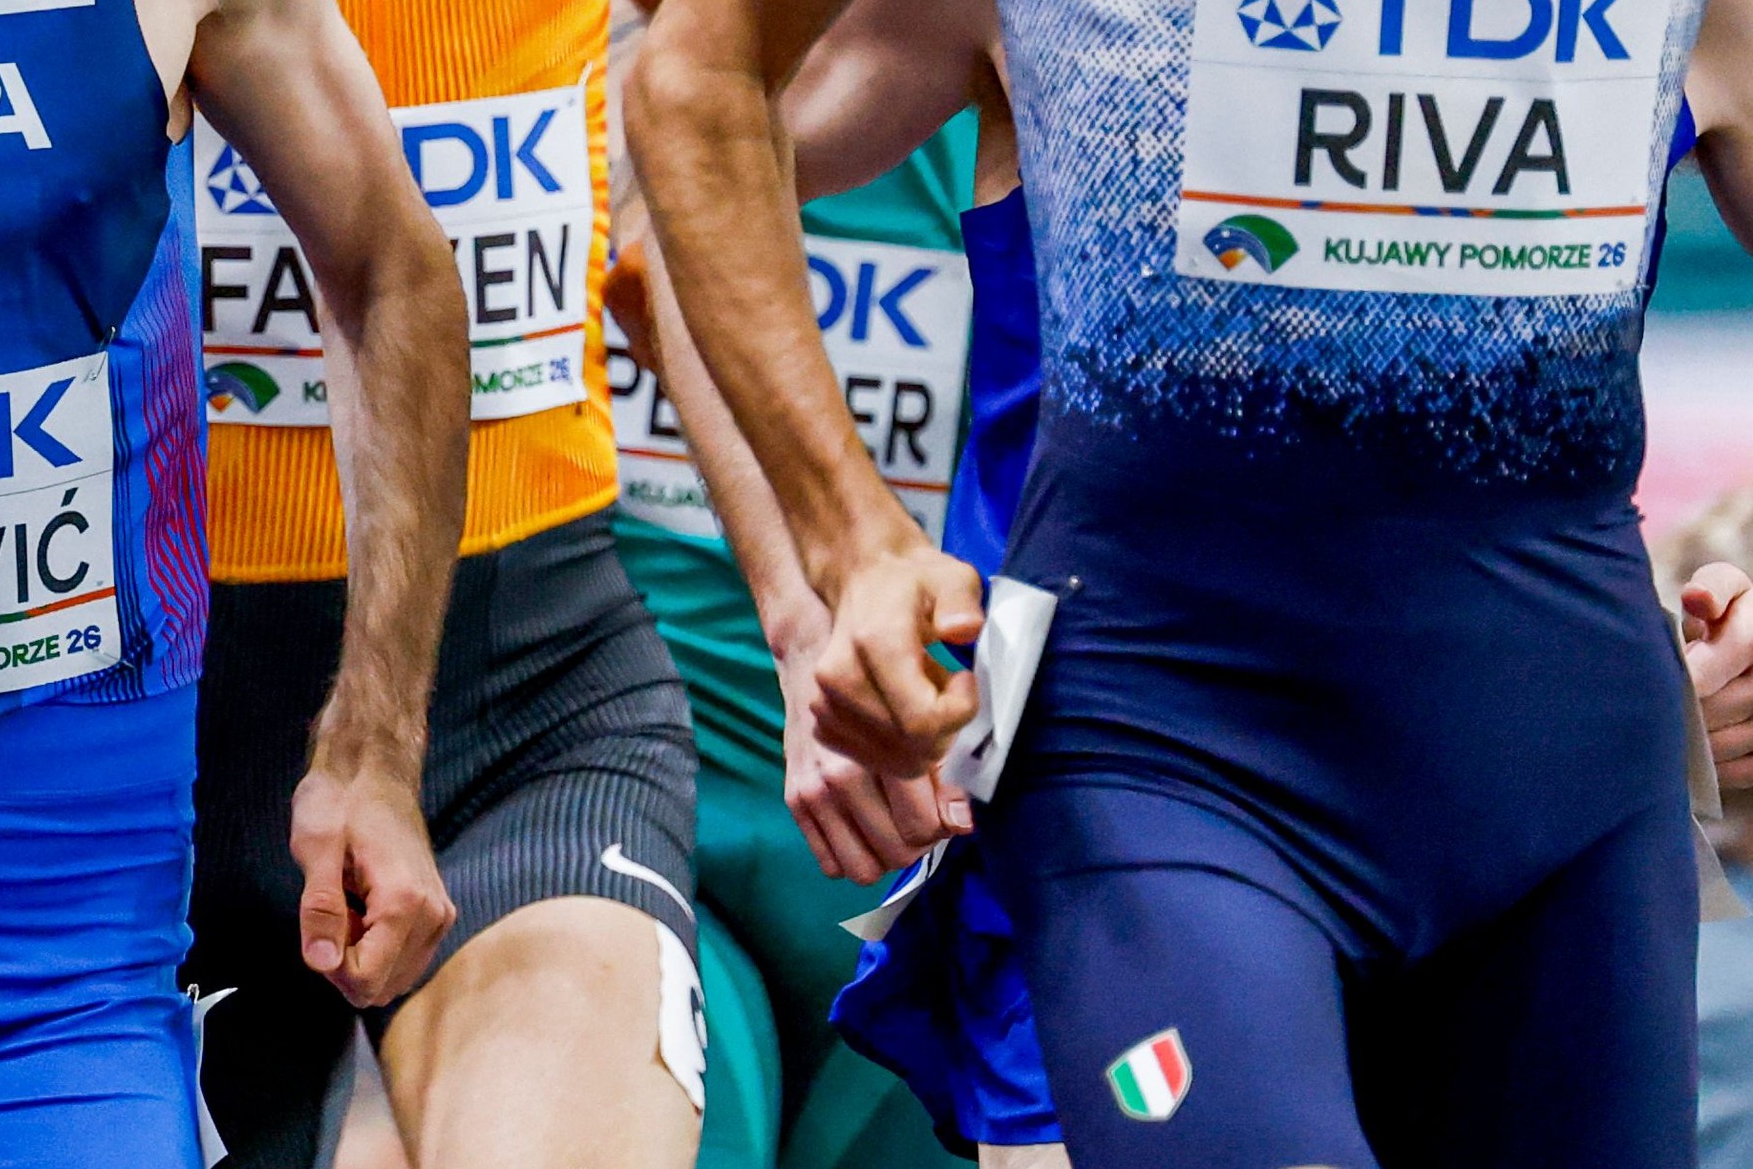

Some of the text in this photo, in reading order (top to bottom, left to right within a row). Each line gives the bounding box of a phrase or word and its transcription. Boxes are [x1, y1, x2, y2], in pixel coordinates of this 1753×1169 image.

[401, 108, 564, 208] DK
[1293, 87, 1571, 197] RIVA
[202, 223, 570, 333] FAEN
[1324, 238, 1627, 270] KUJAWY POMORZE 26
[66, 625, 102, 655] 26
